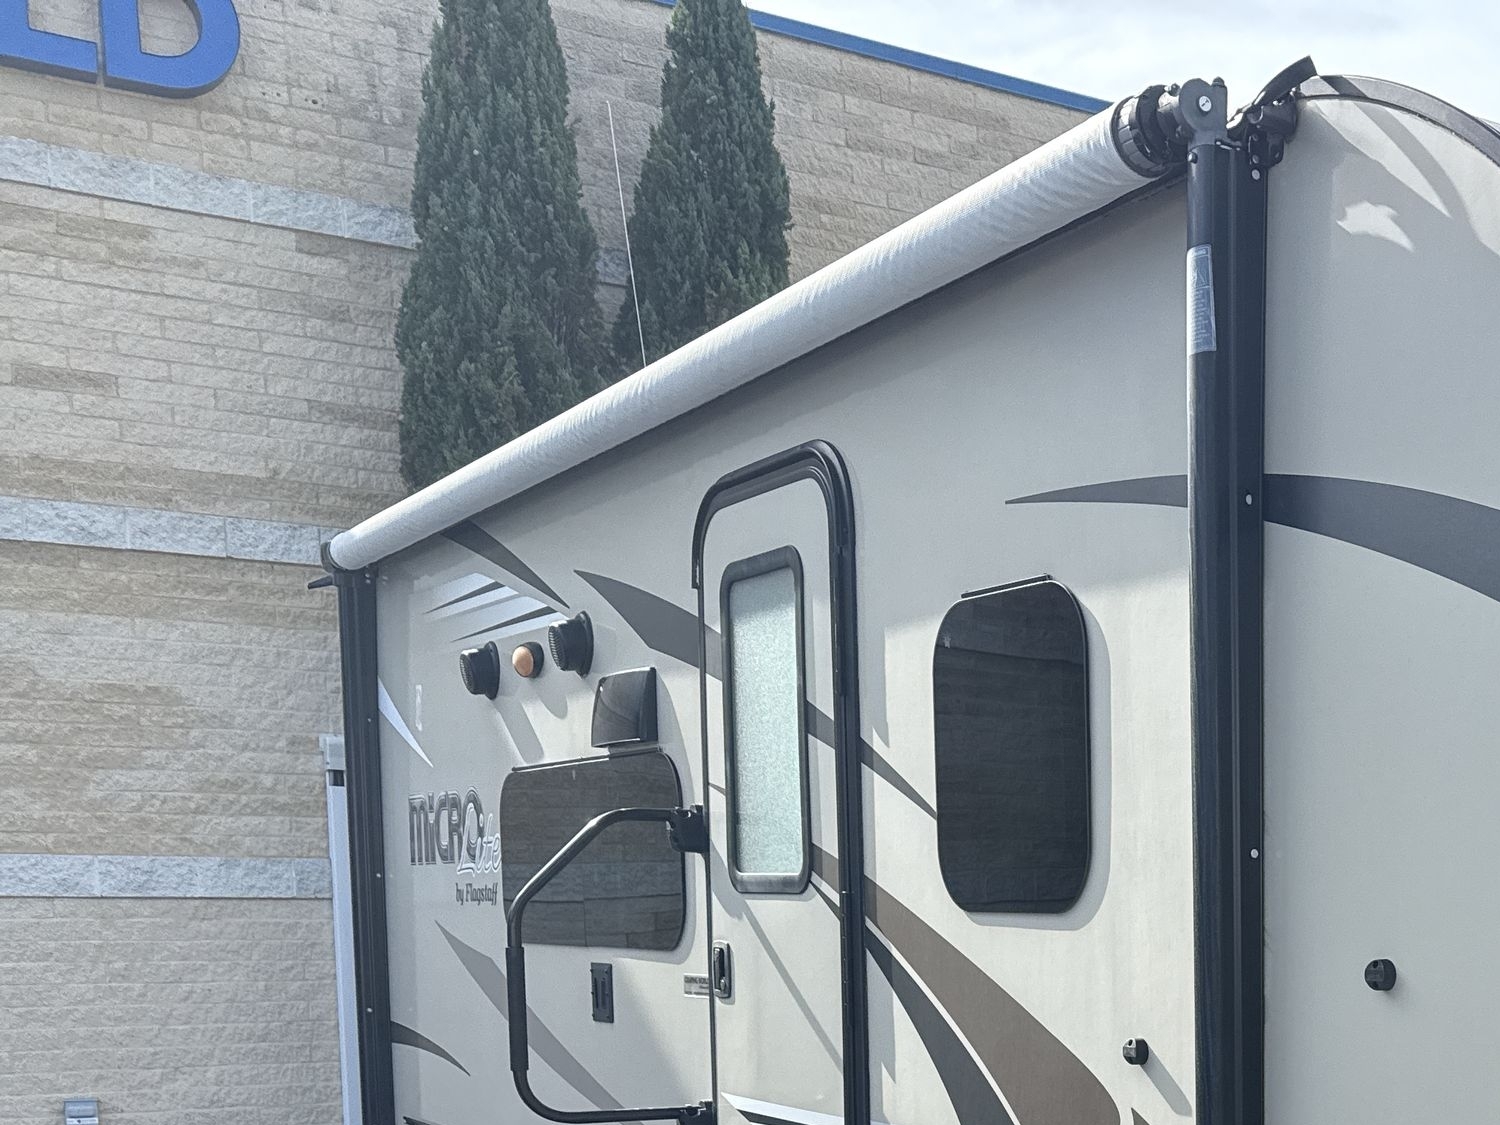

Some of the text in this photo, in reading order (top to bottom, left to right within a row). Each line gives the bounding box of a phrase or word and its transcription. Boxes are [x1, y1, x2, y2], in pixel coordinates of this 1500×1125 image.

[456, 802, 501, 877] Lite
[455, 882, 498, 906] by Flagstaff
